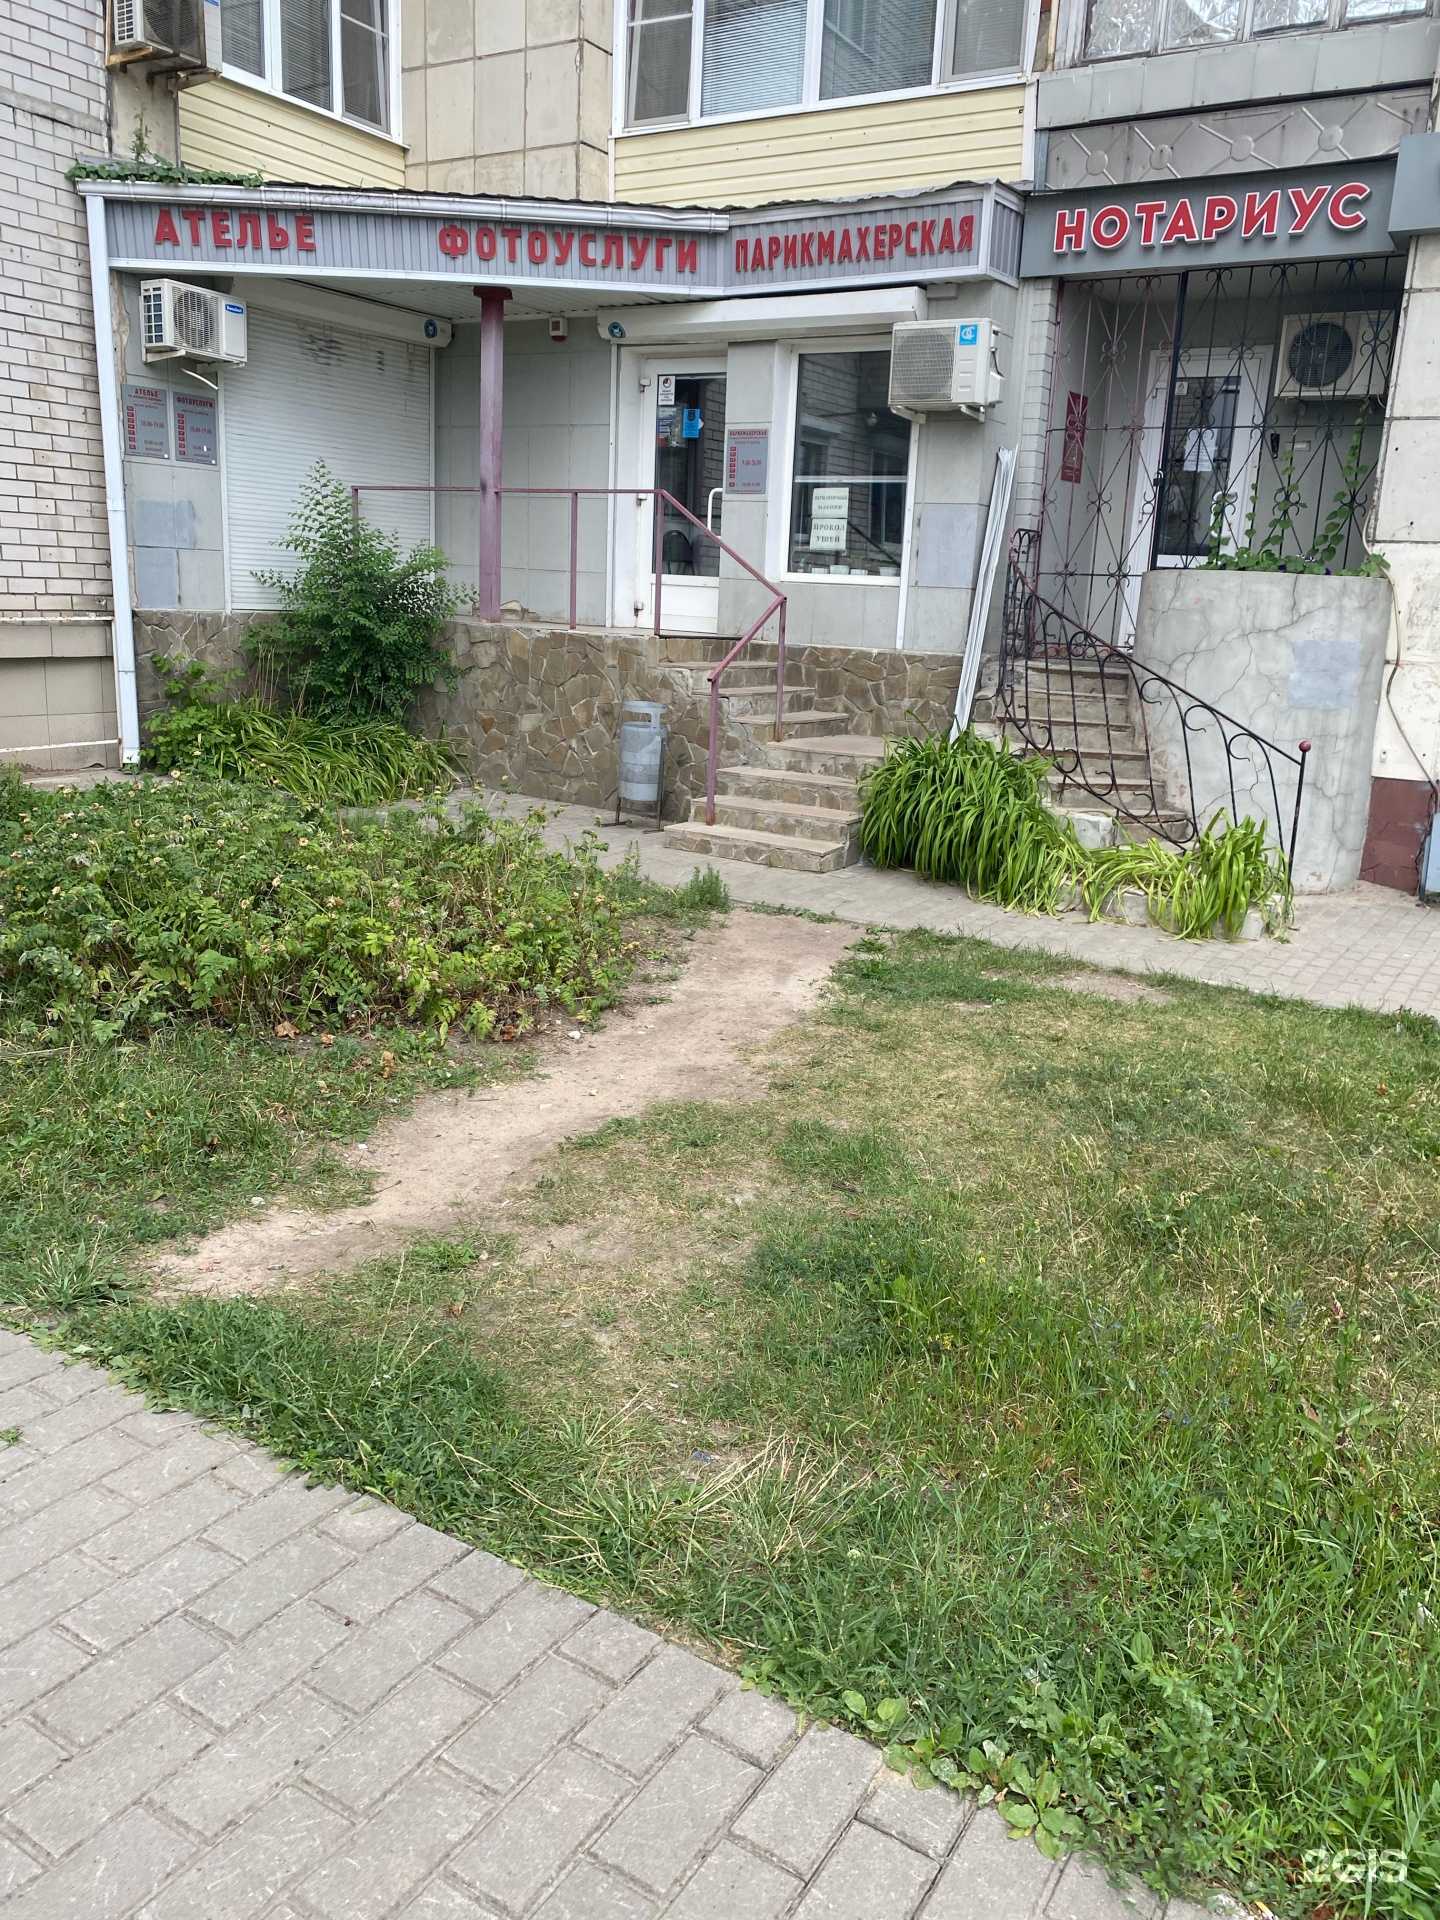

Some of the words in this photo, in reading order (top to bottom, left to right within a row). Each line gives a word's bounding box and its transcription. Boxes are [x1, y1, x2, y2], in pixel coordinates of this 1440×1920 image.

[154, 207, 317, 251] АТЕЛЬЕ
[735, 214, 976, 274] ПАРИКМАХЕРСКАЯ
[1053, 182, 1371, 254] НОТАРИУС
[438, 223, 698, 273] ФОТОУСЛУГИ
